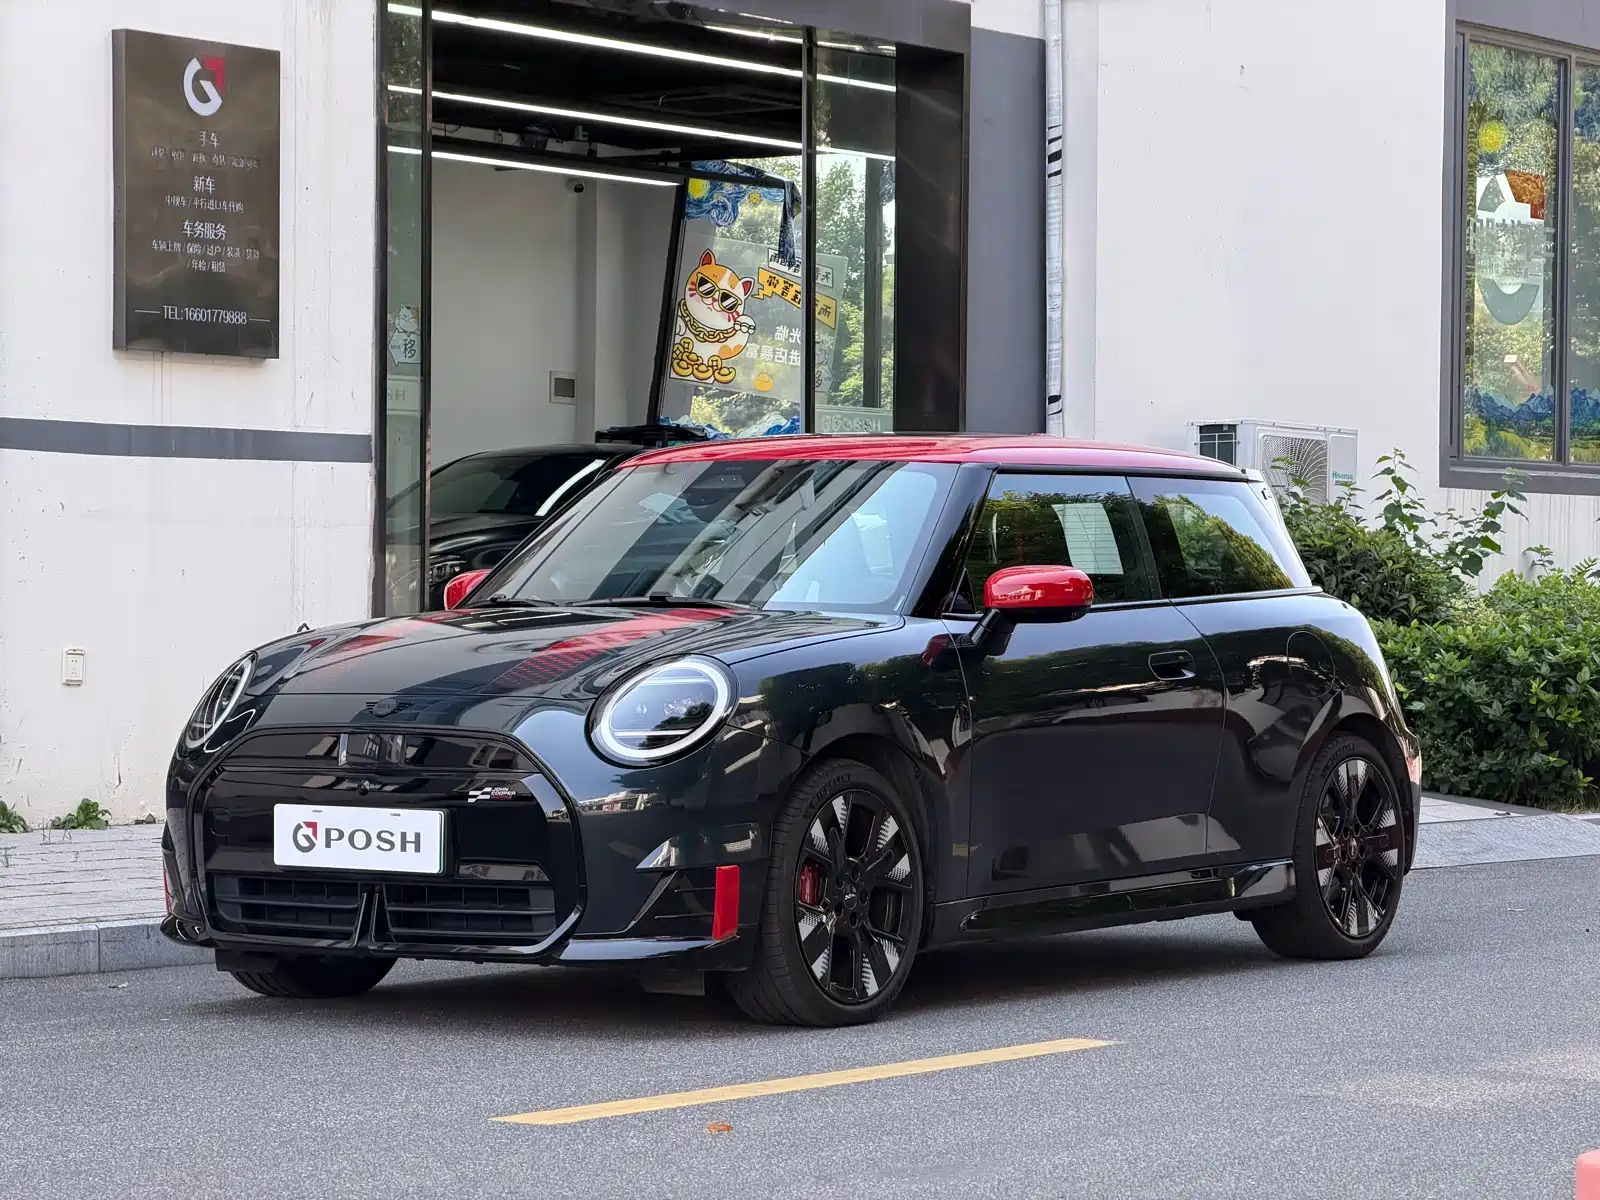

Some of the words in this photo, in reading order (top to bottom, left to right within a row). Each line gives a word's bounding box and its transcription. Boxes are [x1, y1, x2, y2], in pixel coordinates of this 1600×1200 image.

[193, 174, 216, 194] 新车
[182, 220, 227, 241] 车务服务
[162, 304, 248, 325] TEL:16601779888
[403, 338, 417, 359] 移
[324, 827, 421, 853] POSH
